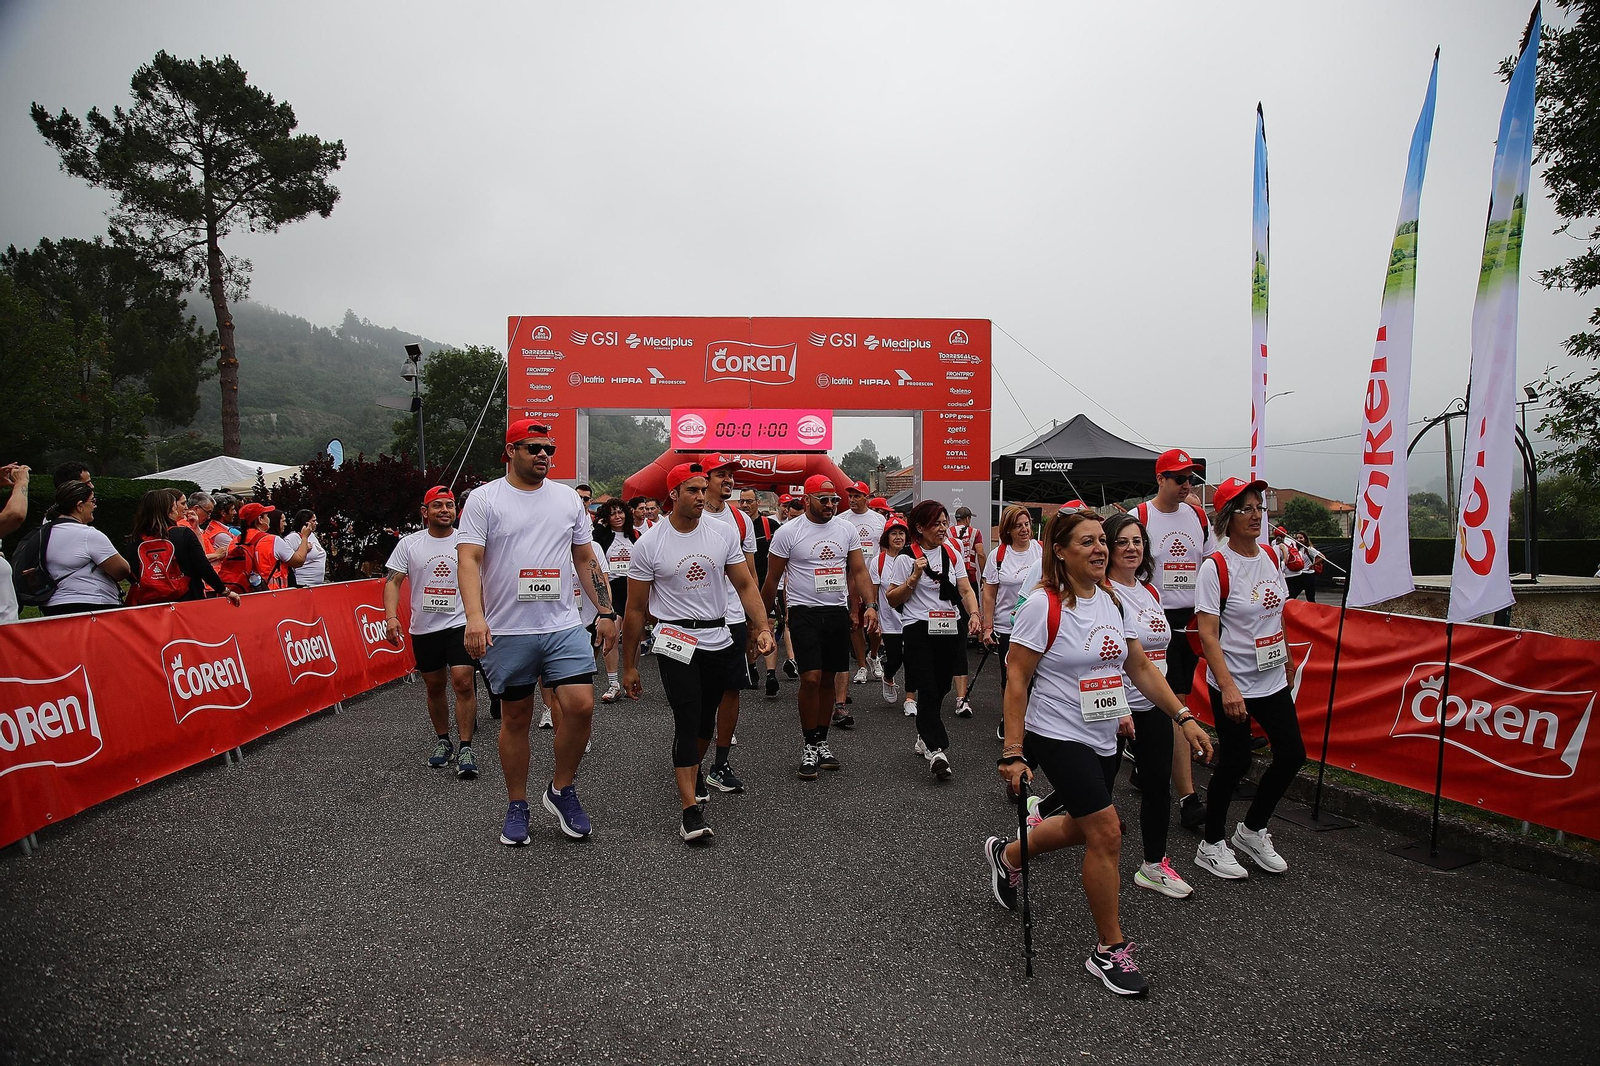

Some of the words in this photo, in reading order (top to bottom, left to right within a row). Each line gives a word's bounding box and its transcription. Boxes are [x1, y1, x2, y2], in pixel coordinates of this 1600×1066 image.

[591, 332, 618, 346] GSI
[643, 336, 693, 350] Mediplus
[830, 333, 857, 348] GSI
[882, 338, 931, 352] Mediplus
[584, 375, 605, 384] Icofrio
[831, 377, 853, 385] Icofrio
[716, 423, 788, 437] 00:01:00
[666, 642, 682, 652] 229
[1268, 649, 1281, 660] 232
[1094, 696, 1117, 708] 1068
